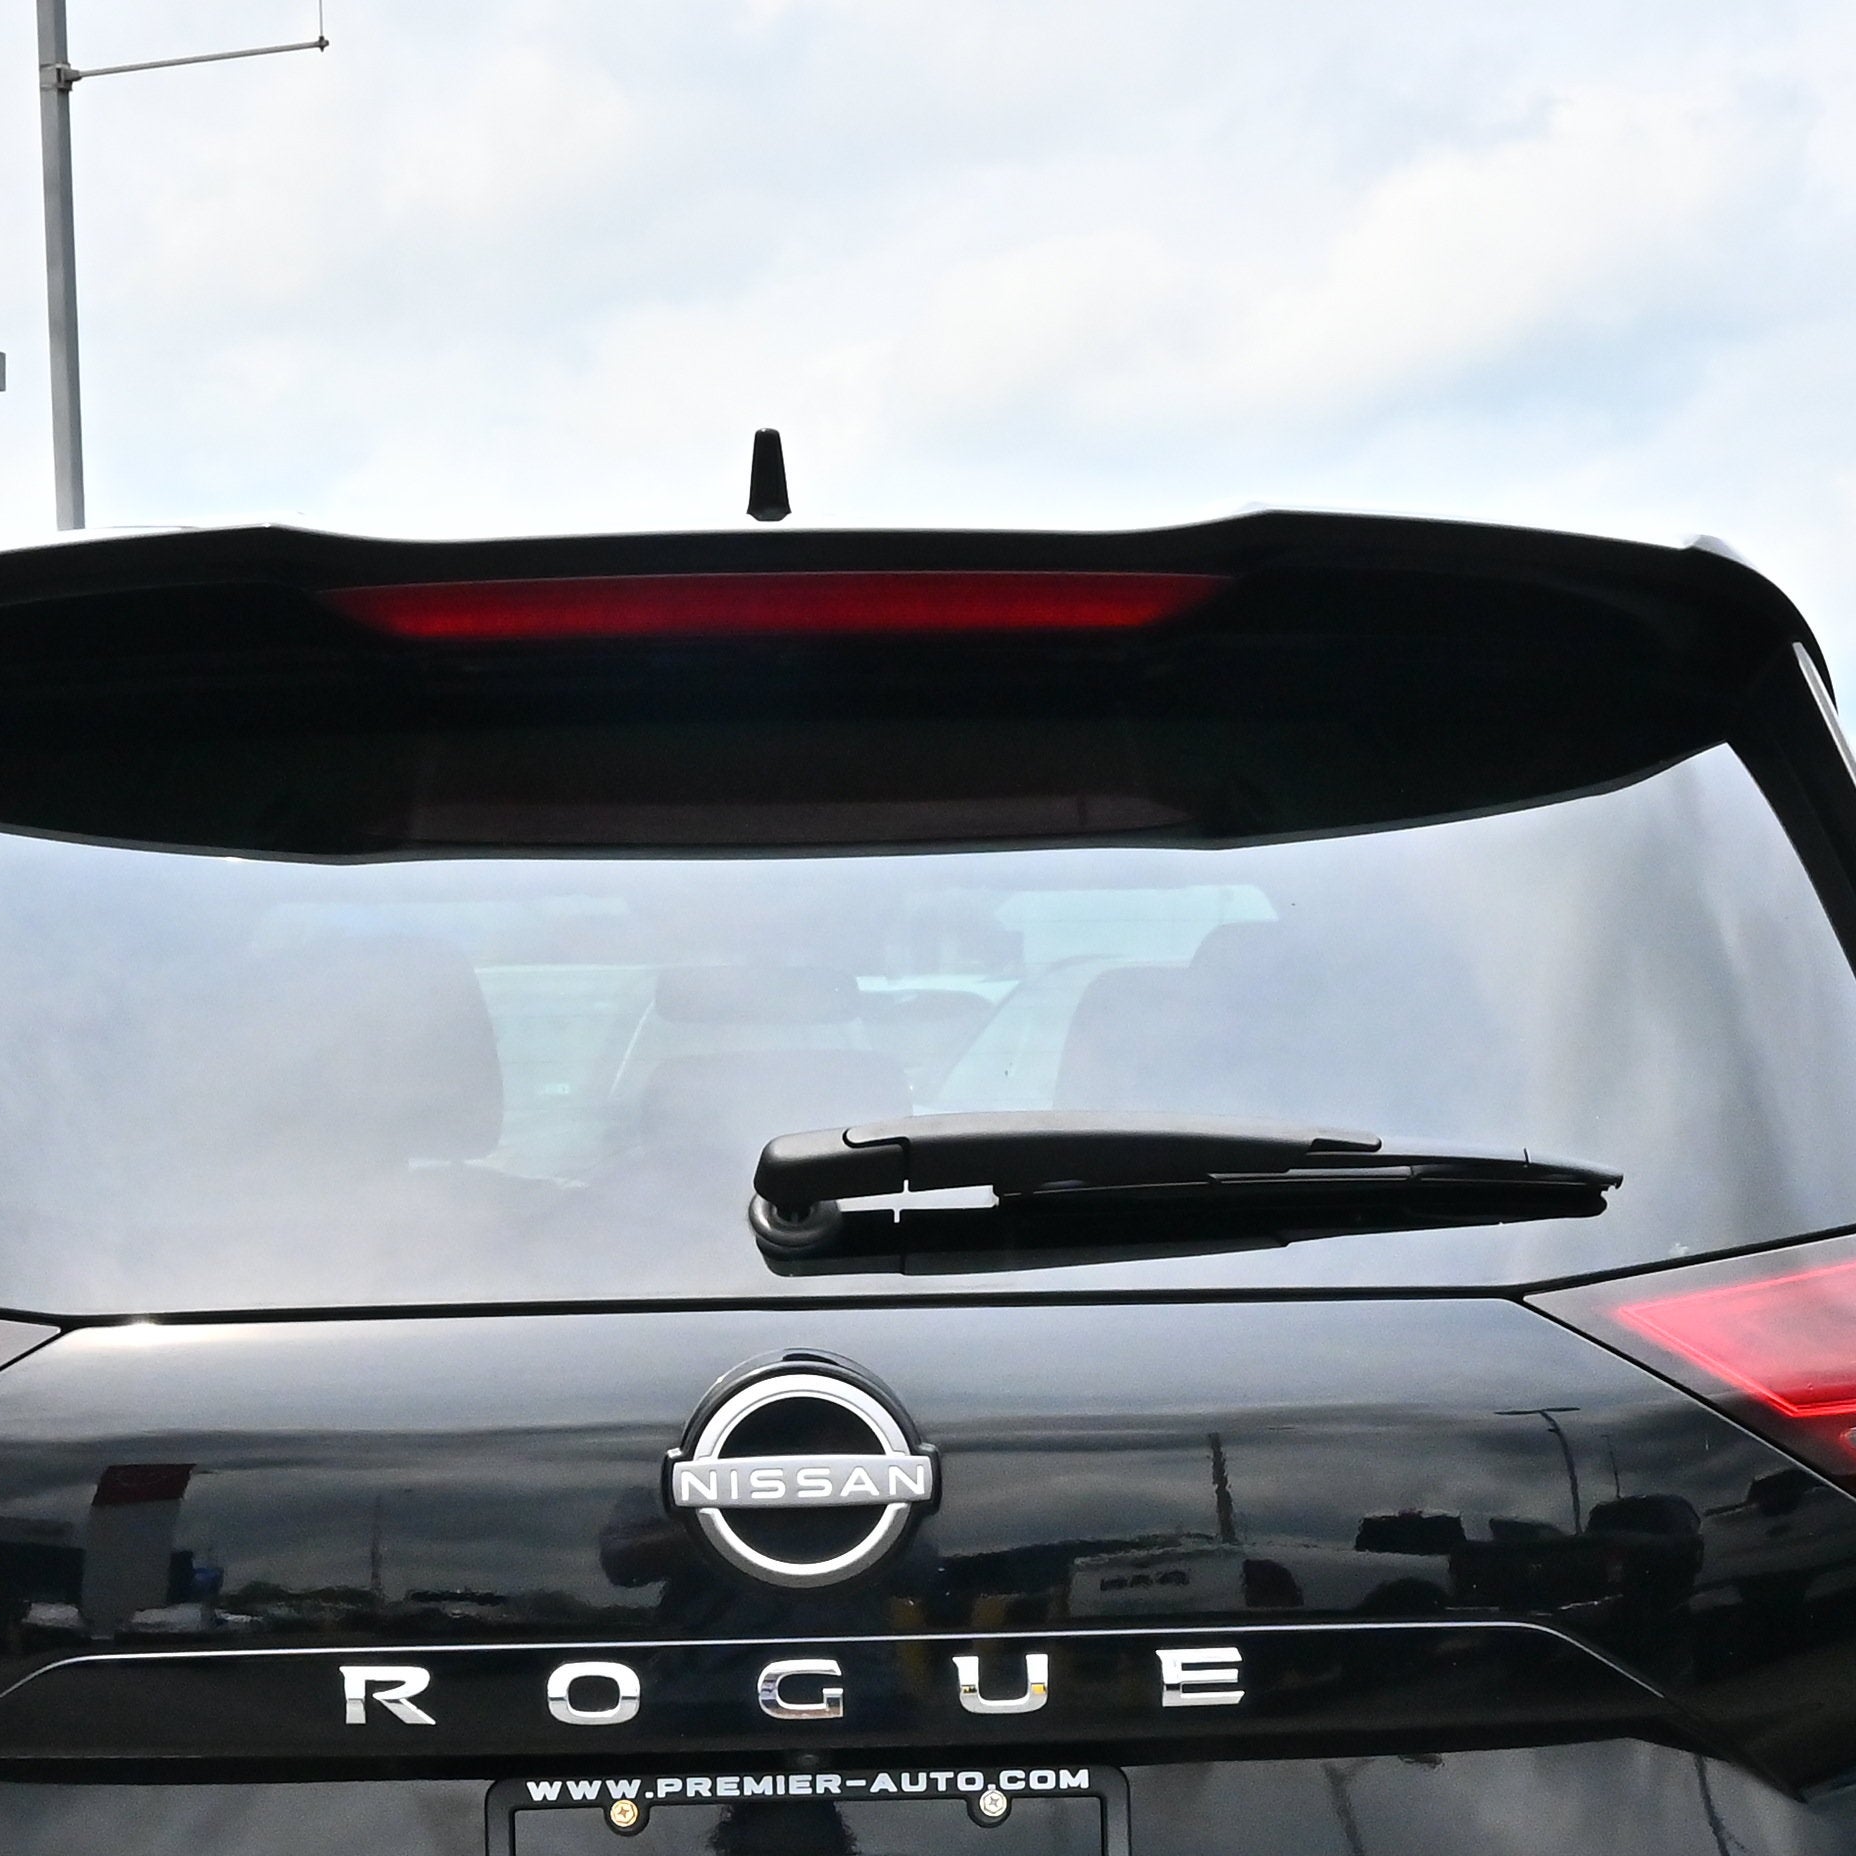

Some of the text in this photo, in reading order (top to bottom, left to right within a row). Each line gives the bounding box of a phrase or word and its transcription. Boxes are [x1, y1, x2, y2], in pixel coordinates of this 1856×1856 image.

[679, 1464, 926, 1502] NISSAN
[338, 1646, 1246, 1726] ROGUE
[526, 1768, 1090, 1803] WWW.PREMIER-AUTO.COM
